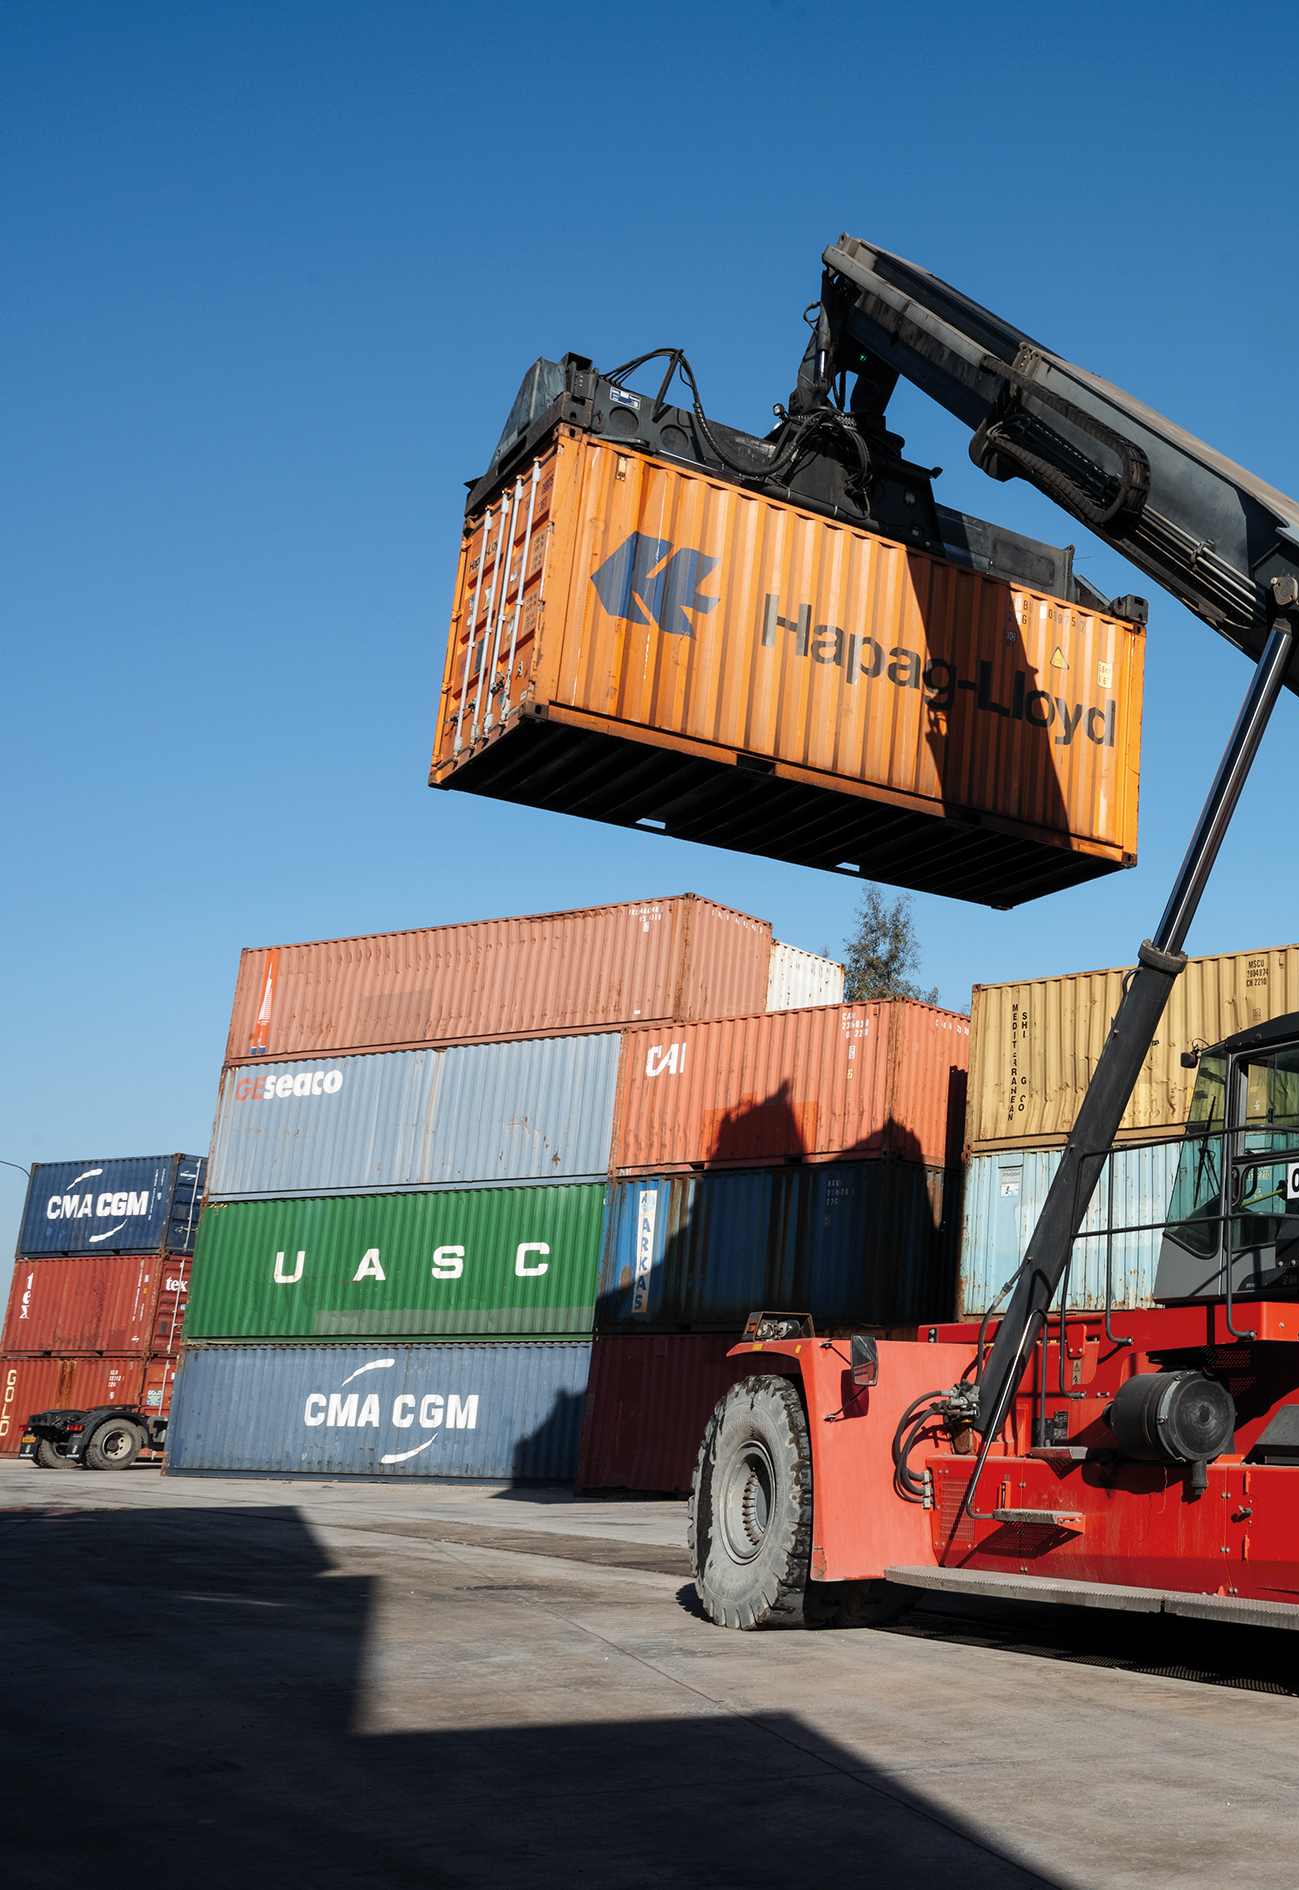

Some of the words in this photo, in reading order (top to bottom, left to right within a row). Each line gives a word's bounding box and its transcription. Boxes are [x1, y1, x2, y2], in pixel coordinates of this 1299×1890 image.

[761, 592, 1116, 748] Hapag-Lloyd
[645, 1042, 687, 1077] CAI
[46, 1193, 93, 1220] CMA
[96, 1190, 150, 1217] CGM
[634, 1217, 651, 1311] ARKAS
[165, 1275, 188, 1292] tex
[304, 1393, 380, 1428] CMA
[392, 1393, 479, 1430] CGM
